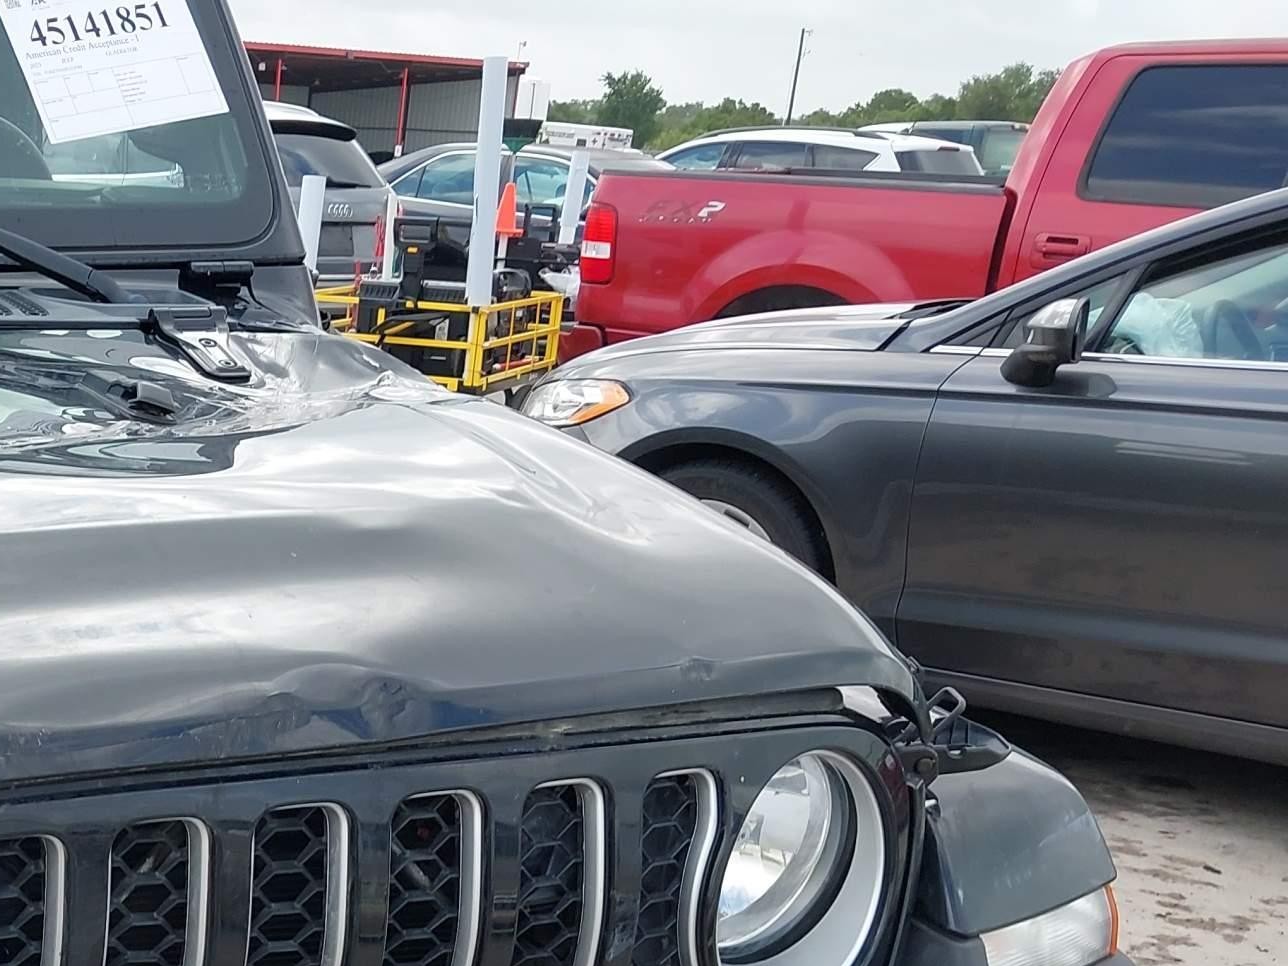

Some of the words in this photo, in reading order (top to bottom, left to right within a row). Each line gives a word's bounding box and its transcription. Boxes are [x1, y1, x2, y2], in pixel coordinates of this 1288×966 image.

[30, 1, 170, 46] 45141851
[25, 47, 62, 60] American
[62, 42, 87, 55] Credit
[88, 37, 129, 50] Acceptance
